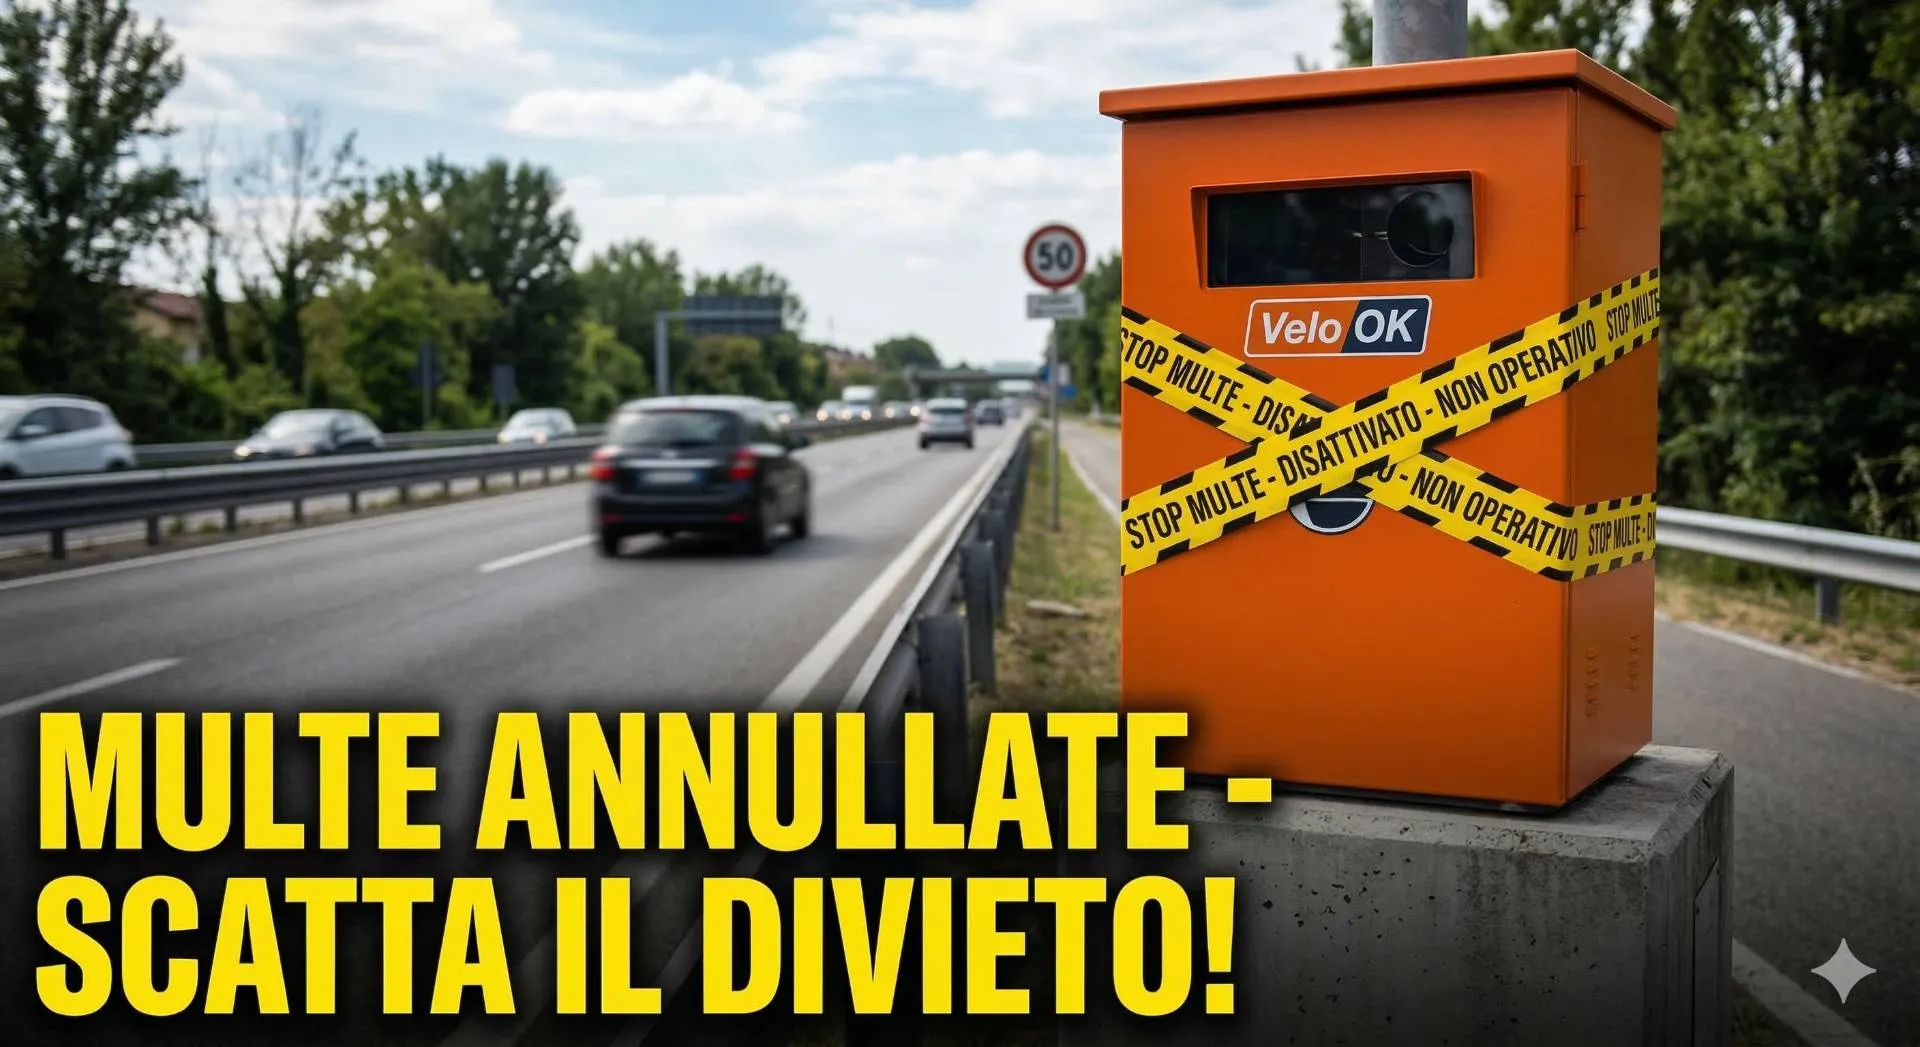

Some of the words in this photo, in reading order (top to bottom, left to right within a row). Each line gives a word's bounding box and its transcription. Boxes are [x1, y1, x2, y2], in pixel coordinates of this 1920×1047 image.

[1037, 241, 1075, 272] 50
[1262, 311, 1342, 344] Velo
[1354, 309, 1419, 343] OK
[1125, 502, 1182, 550] STOP
[1185, 468, 1266, 525] MULTE
[1267, 475, 1277, 483] -
[1276, 401, 1422, 486] DISATTIVATO
[1425, 408, 1433, 416] -
[1434, 371, 1489, 418] NON
[1487, 320, 1596, 395] OPERATIVO
[1606, 302, 1630, 341] STOP
[1631, 288, 1660, 328] MULTE
[1165, 354, 1244, 412] MULTE
[1242, 402, 1251, 410] -
[1410, 466, 1465, 513] NON
[1462, 491, 1578, 561] OPERATIVO
[1588, 521, 1612, 556] STOP
[1613, 515, 1641, 550] MULTE
